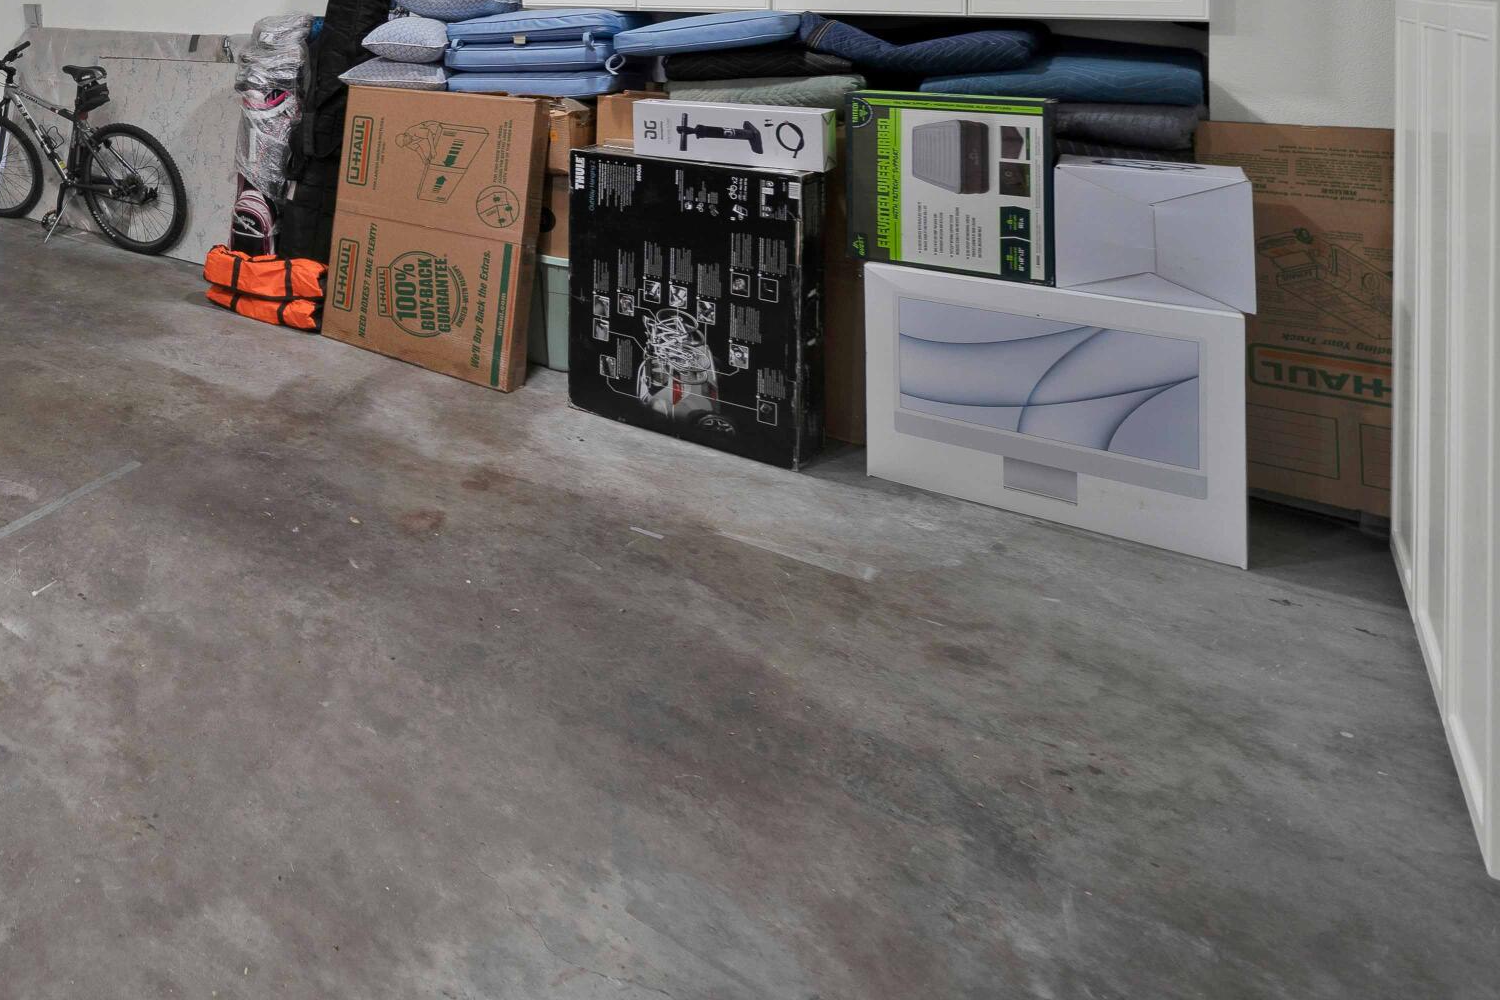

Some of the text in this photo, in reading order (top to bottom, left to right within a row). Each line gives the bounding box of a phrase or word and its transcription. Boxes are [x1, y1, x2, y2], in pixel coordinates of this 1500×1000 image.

[349, 119, 365, 180] U-HAUL
[575, 157, 585, 190] THULE
[877, 118, 890, 248] ELEVATED QUEEN AIRBED
[335, 244, 352, 305] U-HAUL
[358, 223, 378, 338] NEED BOXES? TAKE PLENTY!
[378, 270, 387, 314] U-HAUL
[394, 264, 417, 321] 100%
[417, 257, 435, 331] BUY-BACK
[470, 250, 491, 368] We'll Buy Back the Extras.
[496, 292, 506, 336] uhaul.com
